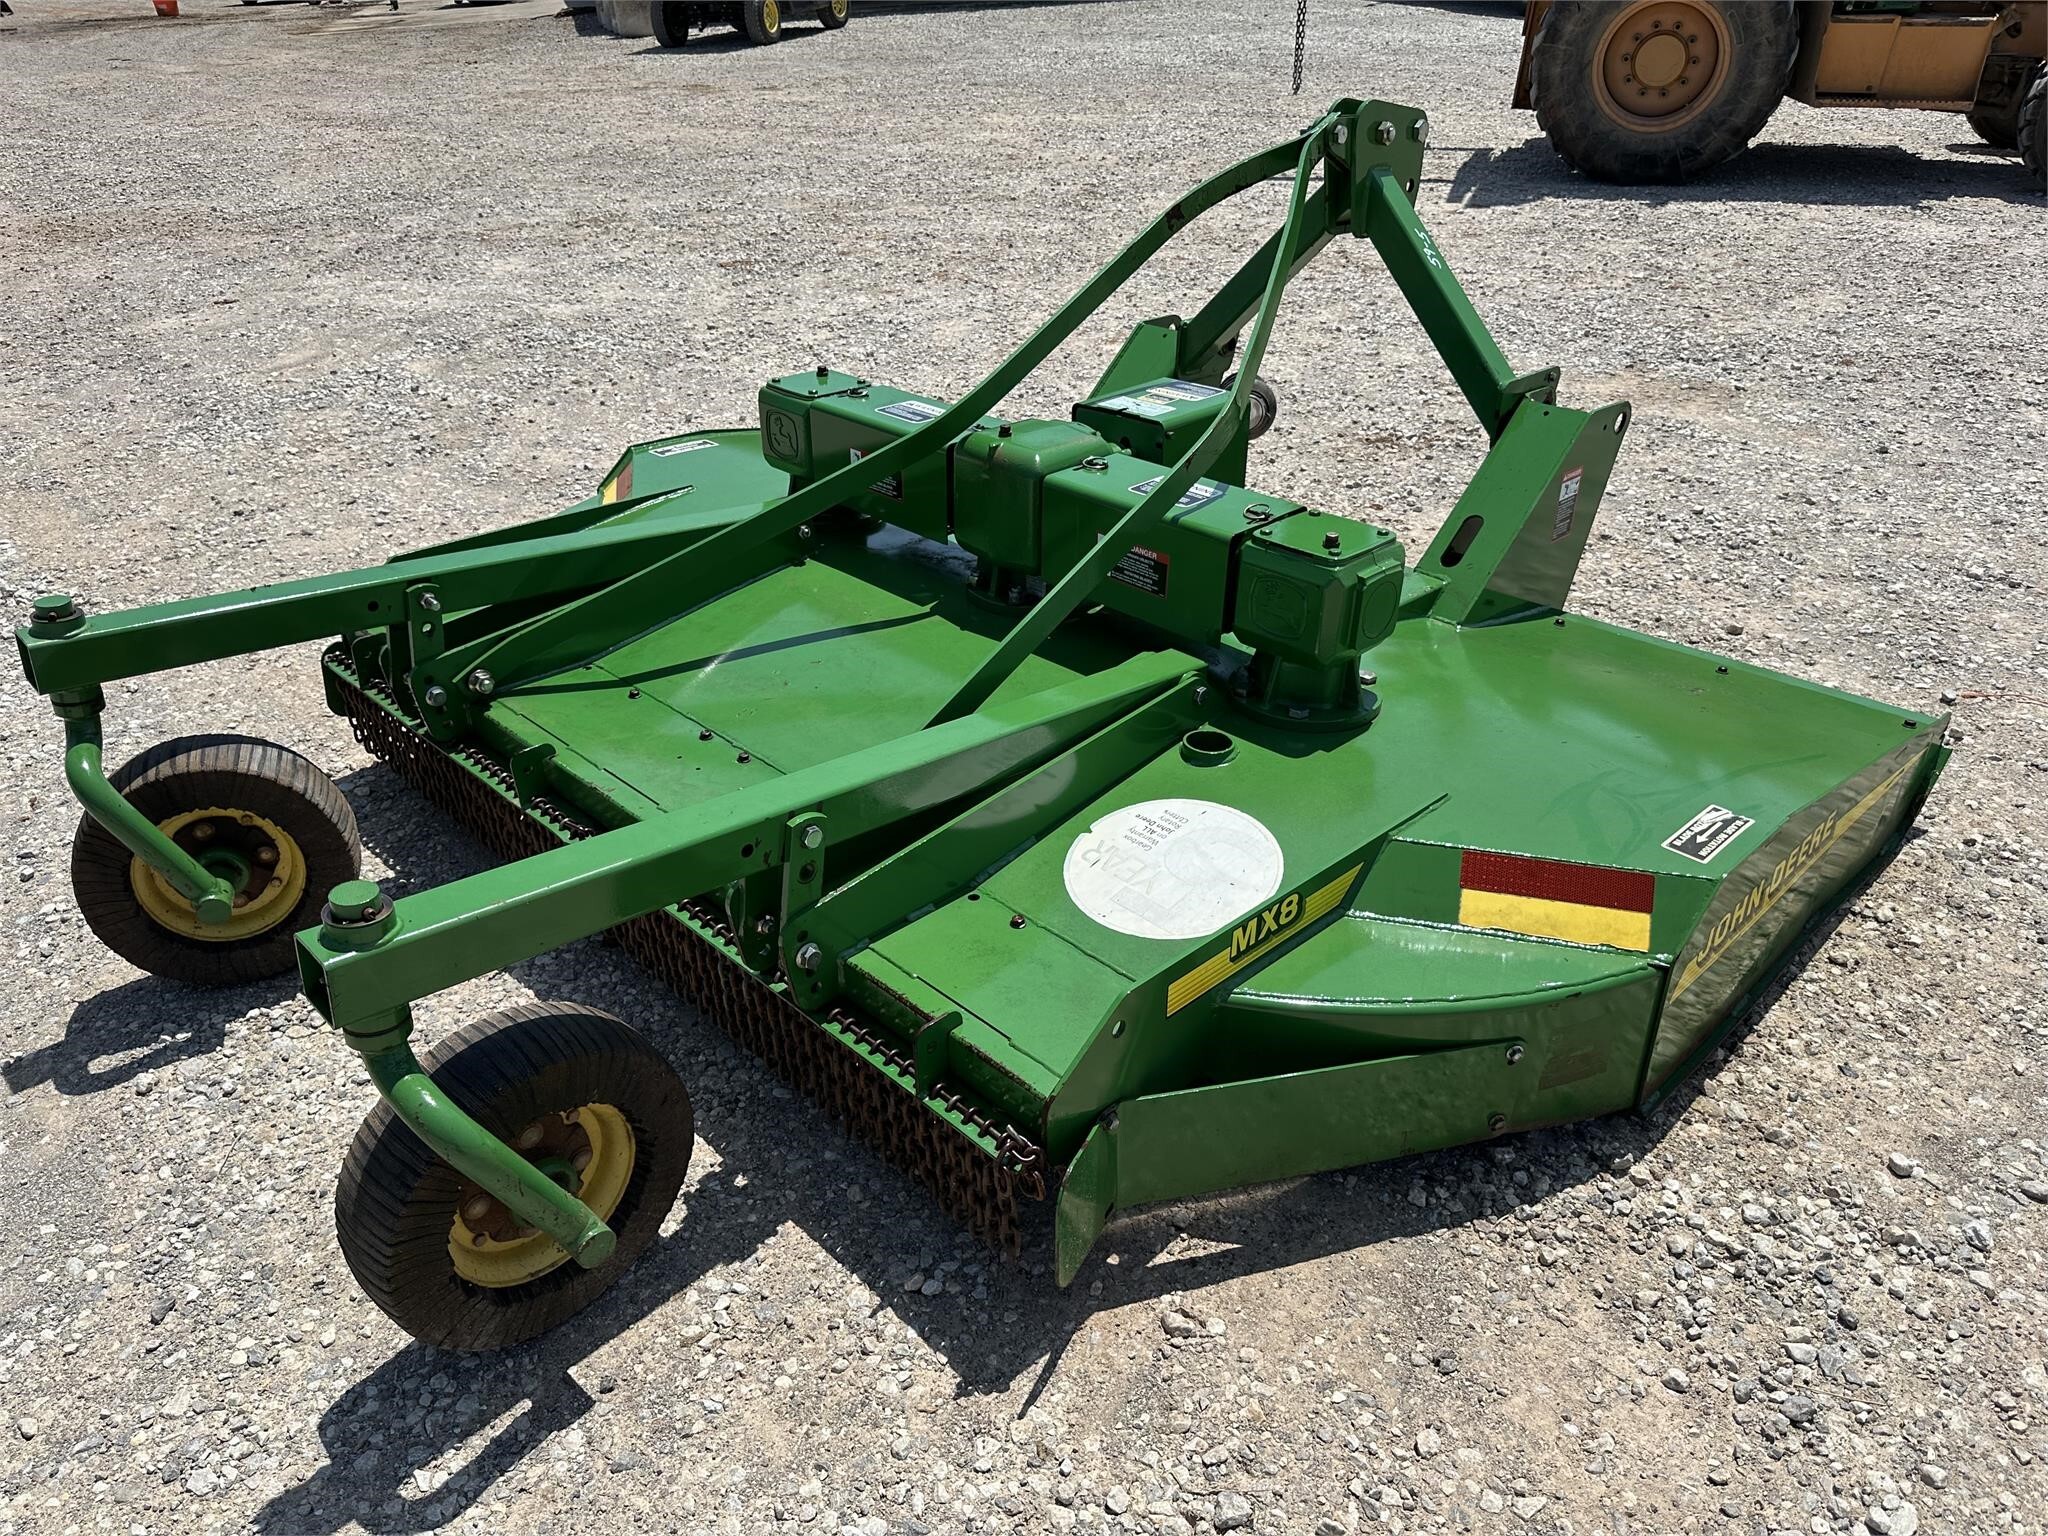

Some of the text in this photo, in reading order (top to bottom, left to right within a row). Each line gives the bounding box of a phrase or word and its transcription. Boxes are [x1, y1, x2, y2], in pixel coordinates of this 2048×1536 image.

[1135, 814, 1175, 834] John Deere
[1142, 826, 1158, 835] ALL
[1723, 819, 1745, 836] BLADE
[1124, 835, 1152, 851] Gearbox
[1130, 826, 1159, 846] Warranty
[1671, 828, 1692, 847] BLADE
[1697, 831, 1729, 857] ROTATION
[1081, 840, 1161, 895] YEAR
[1698, 809, 1838, 963] JOHN DEERE
[1230, 893, 1300, 958] MX8
